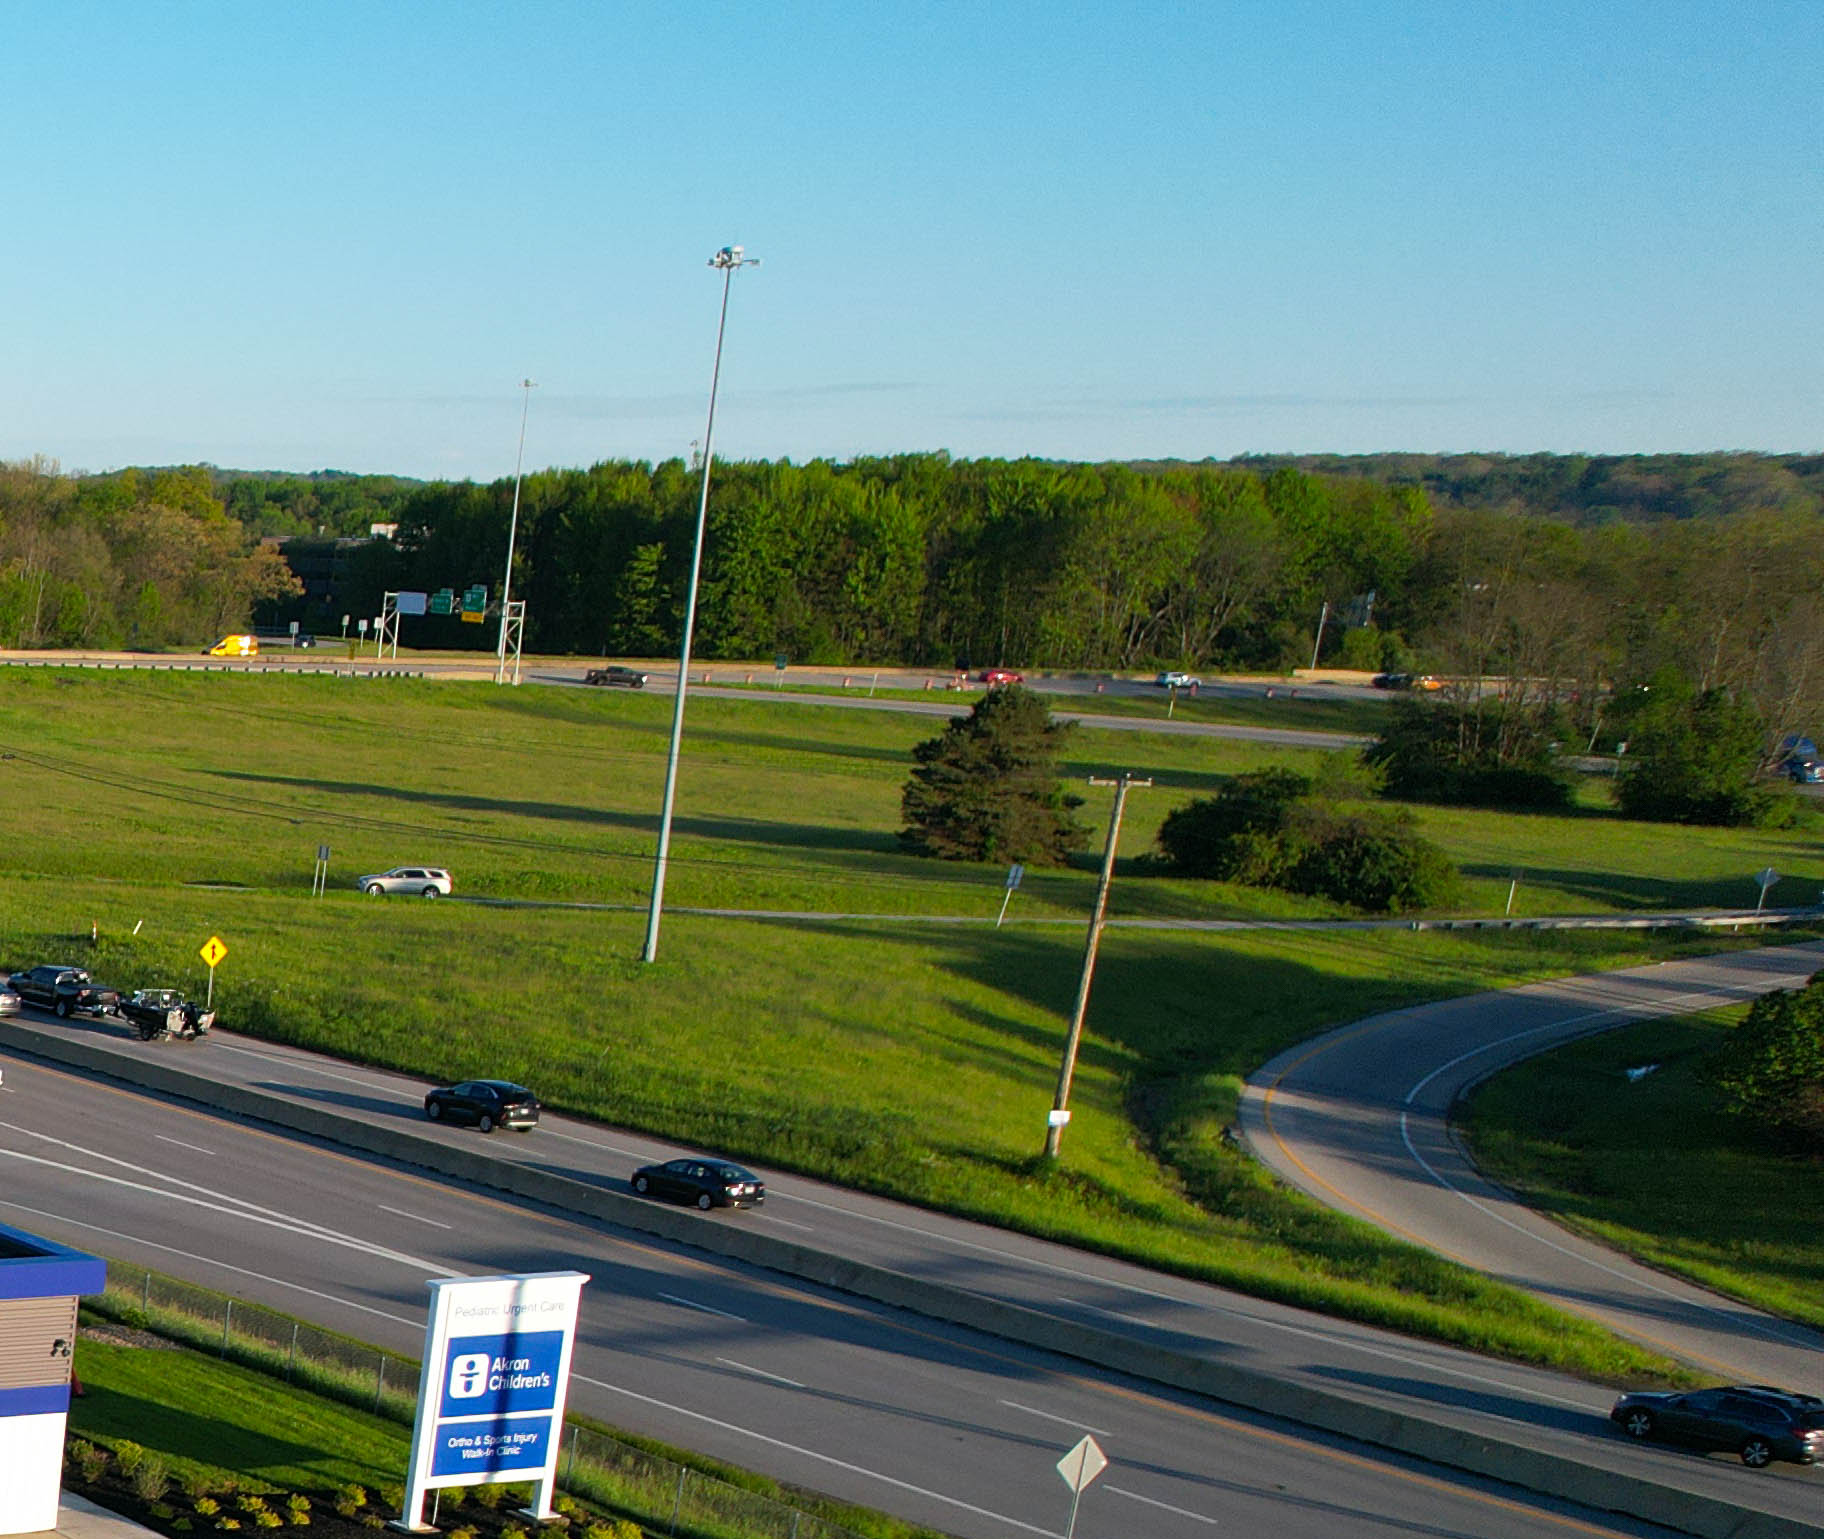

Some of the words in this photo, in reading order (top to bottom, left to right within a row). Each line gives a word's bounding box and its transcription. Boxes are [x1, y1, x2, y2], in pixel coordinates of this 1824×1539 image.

[503, 1303, 537, 1317] Urgent
[540, 1301, 565, 1312] Care
[492, 1357, 530, 1373] Akron
[489, 1372, 550, 1391] Children's
[447, 1436, 473, 1448] Ortho
[483, 1434, 512, 1445] Sports
[513, 1432, 538, 1445] Injury
[462, 1448, 494, 1460] Walk-In
[496, 1445, 523, 1456] Clinic
